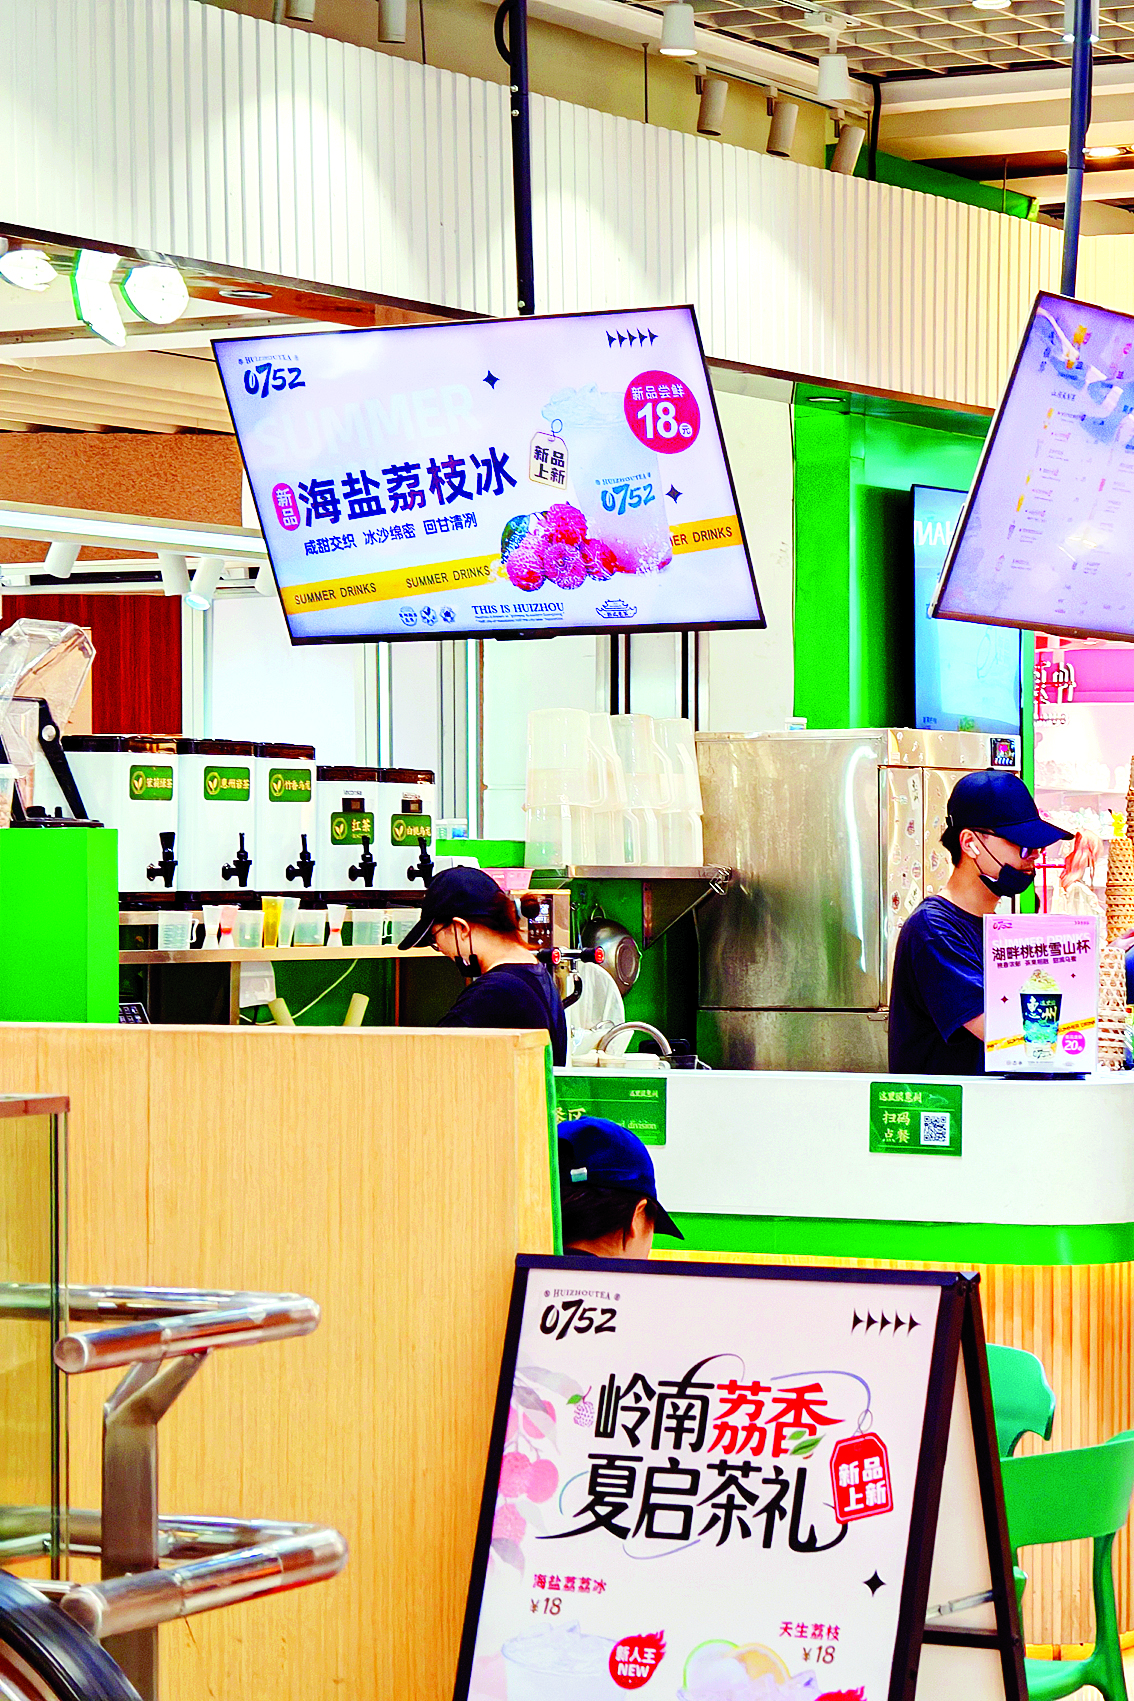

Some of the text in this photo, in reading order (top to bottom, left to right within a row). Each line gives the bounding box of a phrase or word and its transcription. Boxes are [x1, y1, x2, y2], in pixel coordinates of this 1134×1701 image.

[244, 363, 306, 398] 0752
[631, 384, 685, 400] 新品尝鲜
[637, 402, 678, 439] 18
[533, 445, 566, 468] 新品
[533, 463, 566, 485] 上新
[298, 447, 517, 527] 海盐荔枝冰
[274, 488, 299, 527] 新品
[601, 484, 656, 515] 0752
[304, 533, 358, 556] 咸甜交织
[362, 522, 417, 546] 冰沙绵密
[692, 526, 733, 543] DRINKS
[405, 565, 491, 589] SUMMER DRINKS
[294, 582, 377, 605] SUMMER DRINKS
[472, 602, 565, 614] THIS IS HUIZHOU
[351, 818, 371, 832] 红茶
[992, 939, 1091, 962] 湖畔桃桃雪山杯
[628, 1119, 657, 1130] division
[882, 1110, 911, 1126] 扫码
[882, 1128, 911, 1143] 点餐
[553, 1289, 610, 1300] HUIZHOUTEA
[540, 1298, 617, 1341] 0752
[594, 1362, 845, 1459] 岭南荔香
[838, 1455, 885, 1488] 新品
[535, 1453, 848, 1553] 夏启茶礼
[843, 1483, 888, 1512] 上新
[779, 1621, 841, 1642] 天生荔枝
[615, 1645, 657, 1665] 新人王
[617, 1663, 650, 1678] NEW
